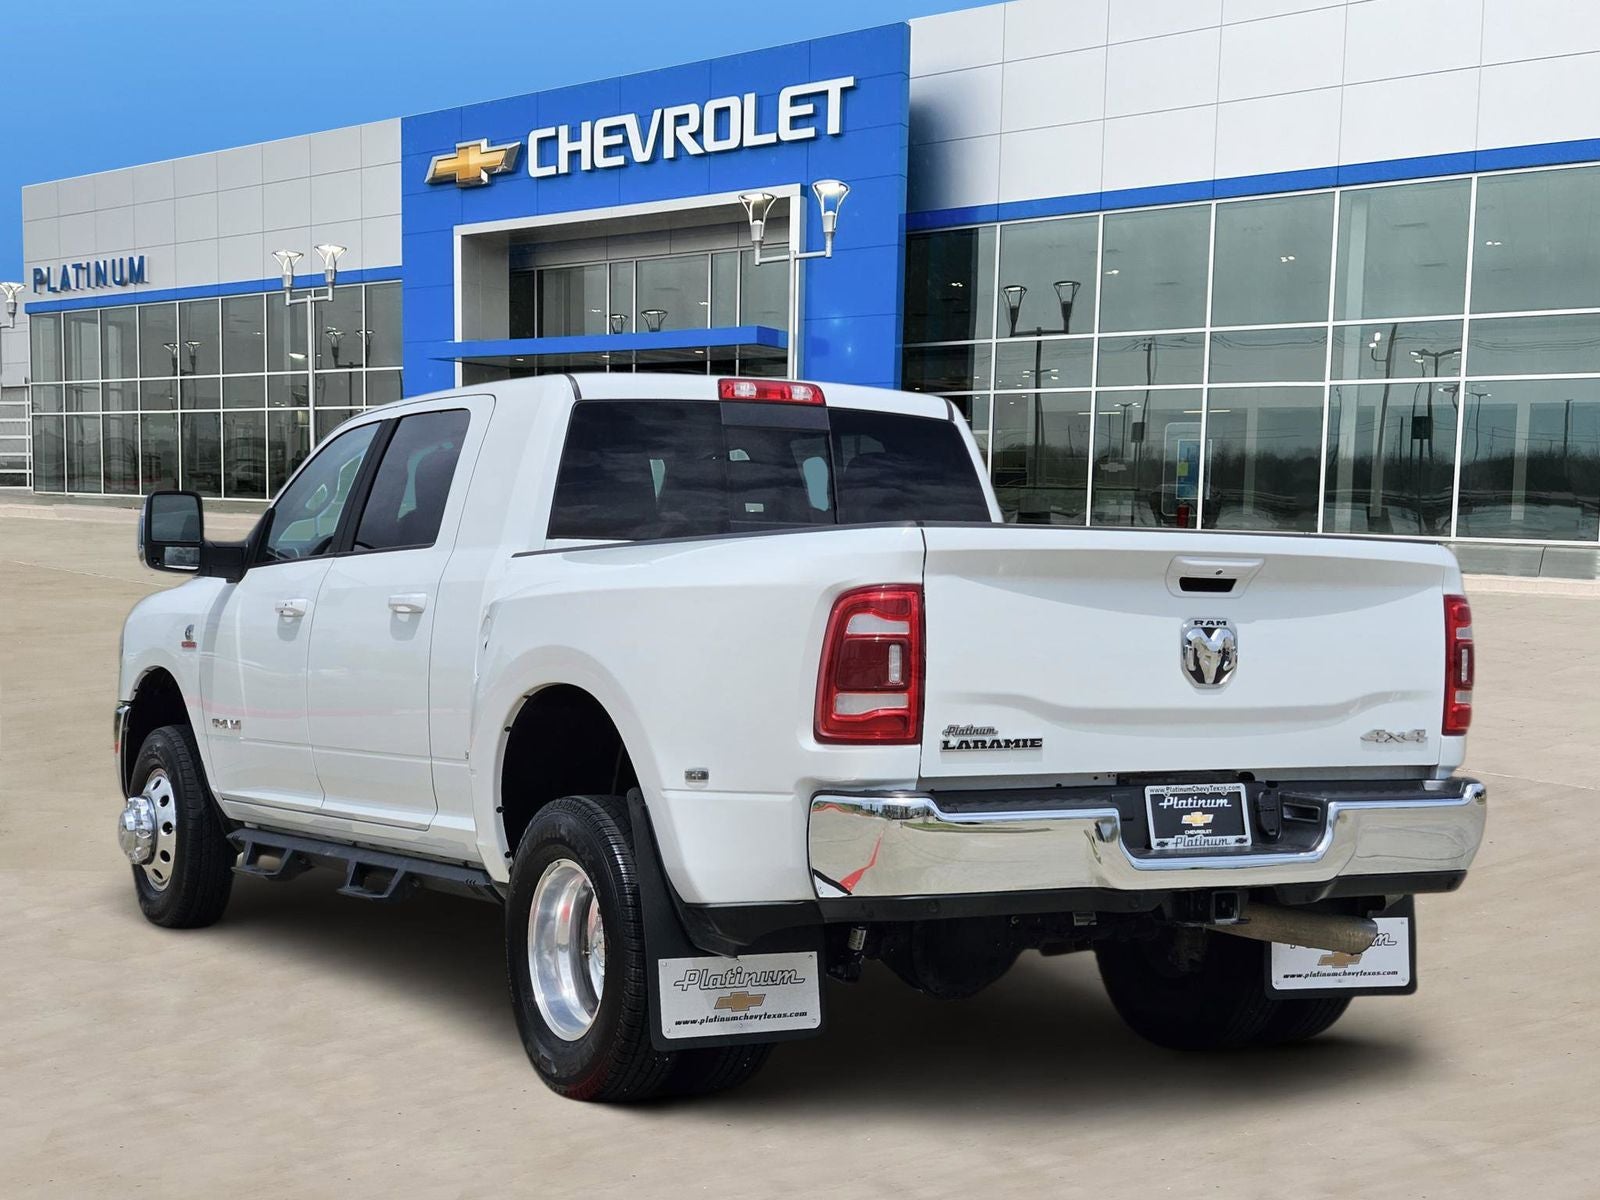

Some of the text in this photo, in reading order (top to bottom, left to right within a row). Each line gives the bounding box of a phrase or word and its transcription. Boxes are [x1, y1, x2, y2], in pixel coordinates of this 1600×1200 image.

[528, 76, 855, 178] CHEVROLET
[33, 255, 146, 293] PLATINUM
[942, 724, 999, 737] Platinum
[942, 738, 1043, 750] LARAMIE
[1158, 796, 1232, 809] Platinum
[1171, 835, 1232, 848] Platinum
[673, 966, 806, 991] Platinum
[1283, 970, 1399, 979] www.platinumchevytexas.com
[675, 1011, 808, 1026] www.platinumchevytexas.com
